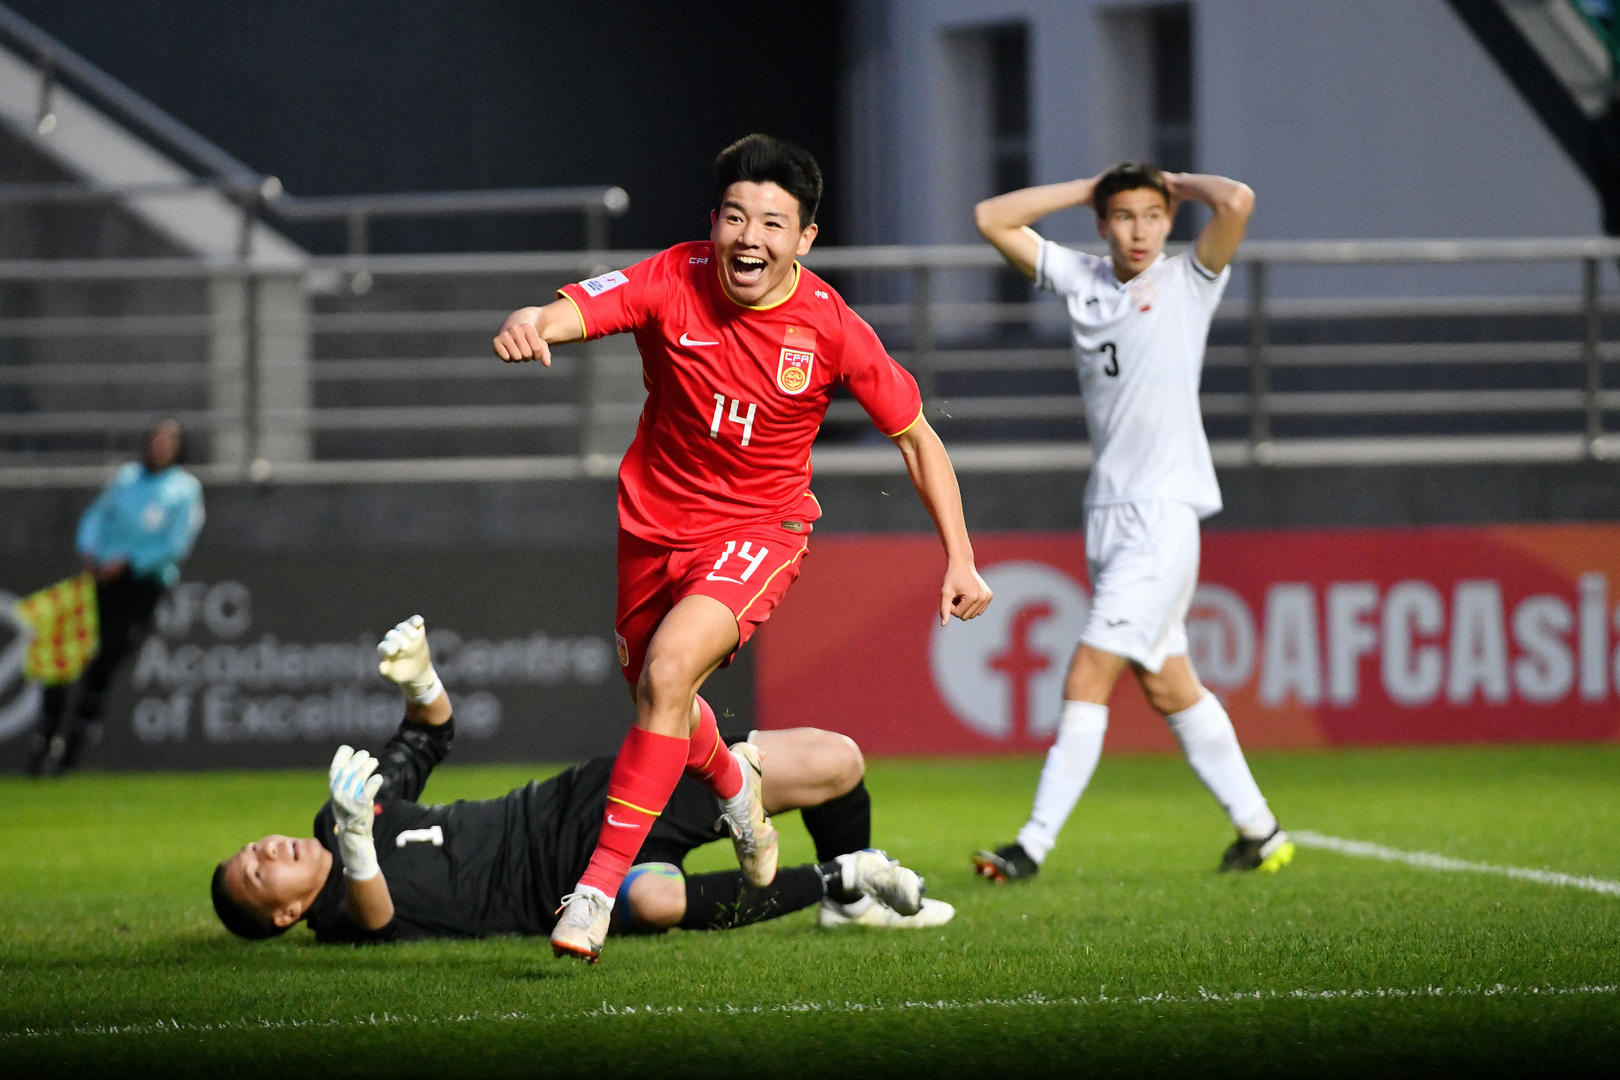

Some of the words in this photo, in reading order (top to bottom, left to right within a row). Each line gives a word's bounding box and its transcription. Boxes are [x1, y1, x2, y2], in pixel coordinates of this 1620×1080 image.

[785, 352, 809, 363] CFA
[1100, 342, 1119, 377] 3
[709, 392, 757, 447] 14
[712, 540, 769, 582] 14
[1187, 572, 1620, 705] @AFCAsi
[395, 825, 444, 847] 1
